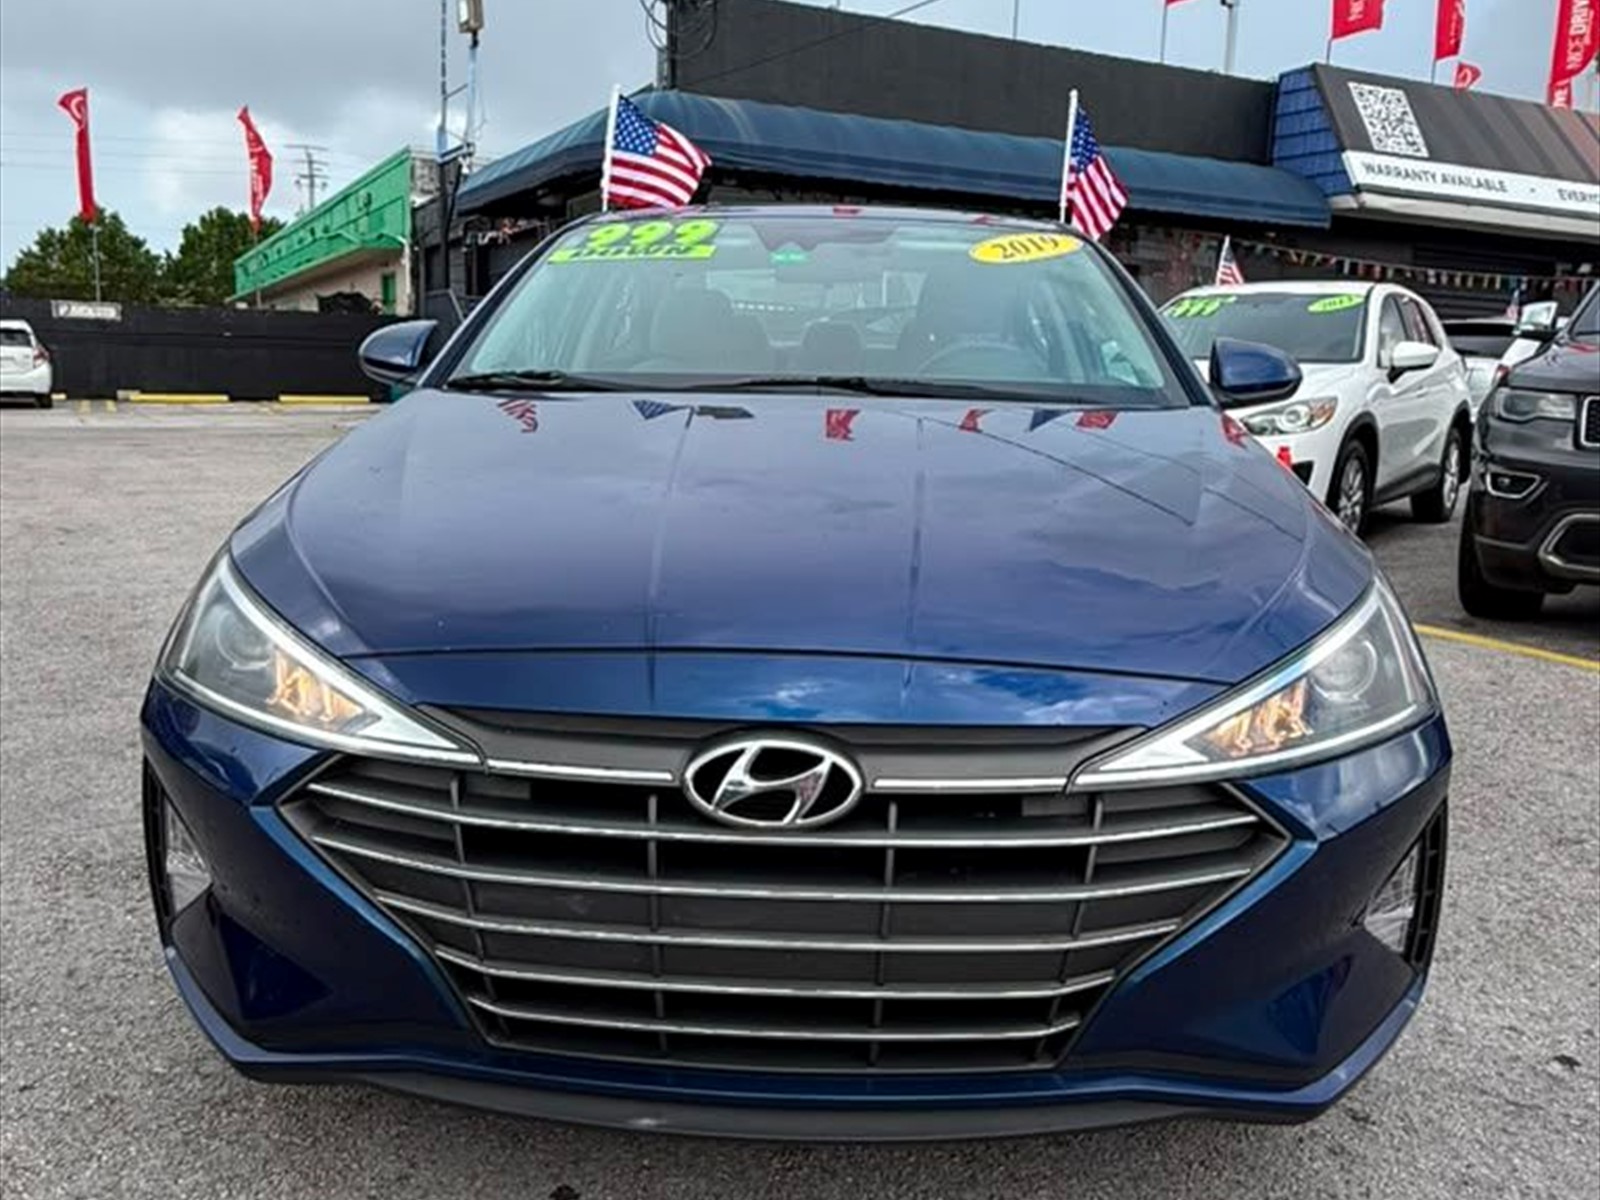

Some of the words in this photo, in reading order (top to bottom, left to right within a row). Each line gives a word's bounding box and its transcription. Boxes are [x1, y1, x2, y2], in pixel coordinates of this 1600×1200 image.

[1361, 161, 1438, 184] WARRANTY
[1440, 173, 1509, 194] AVAILABLE
[586, 220, 718, 250] 999
[990, 234, 1061, 260] 2019
